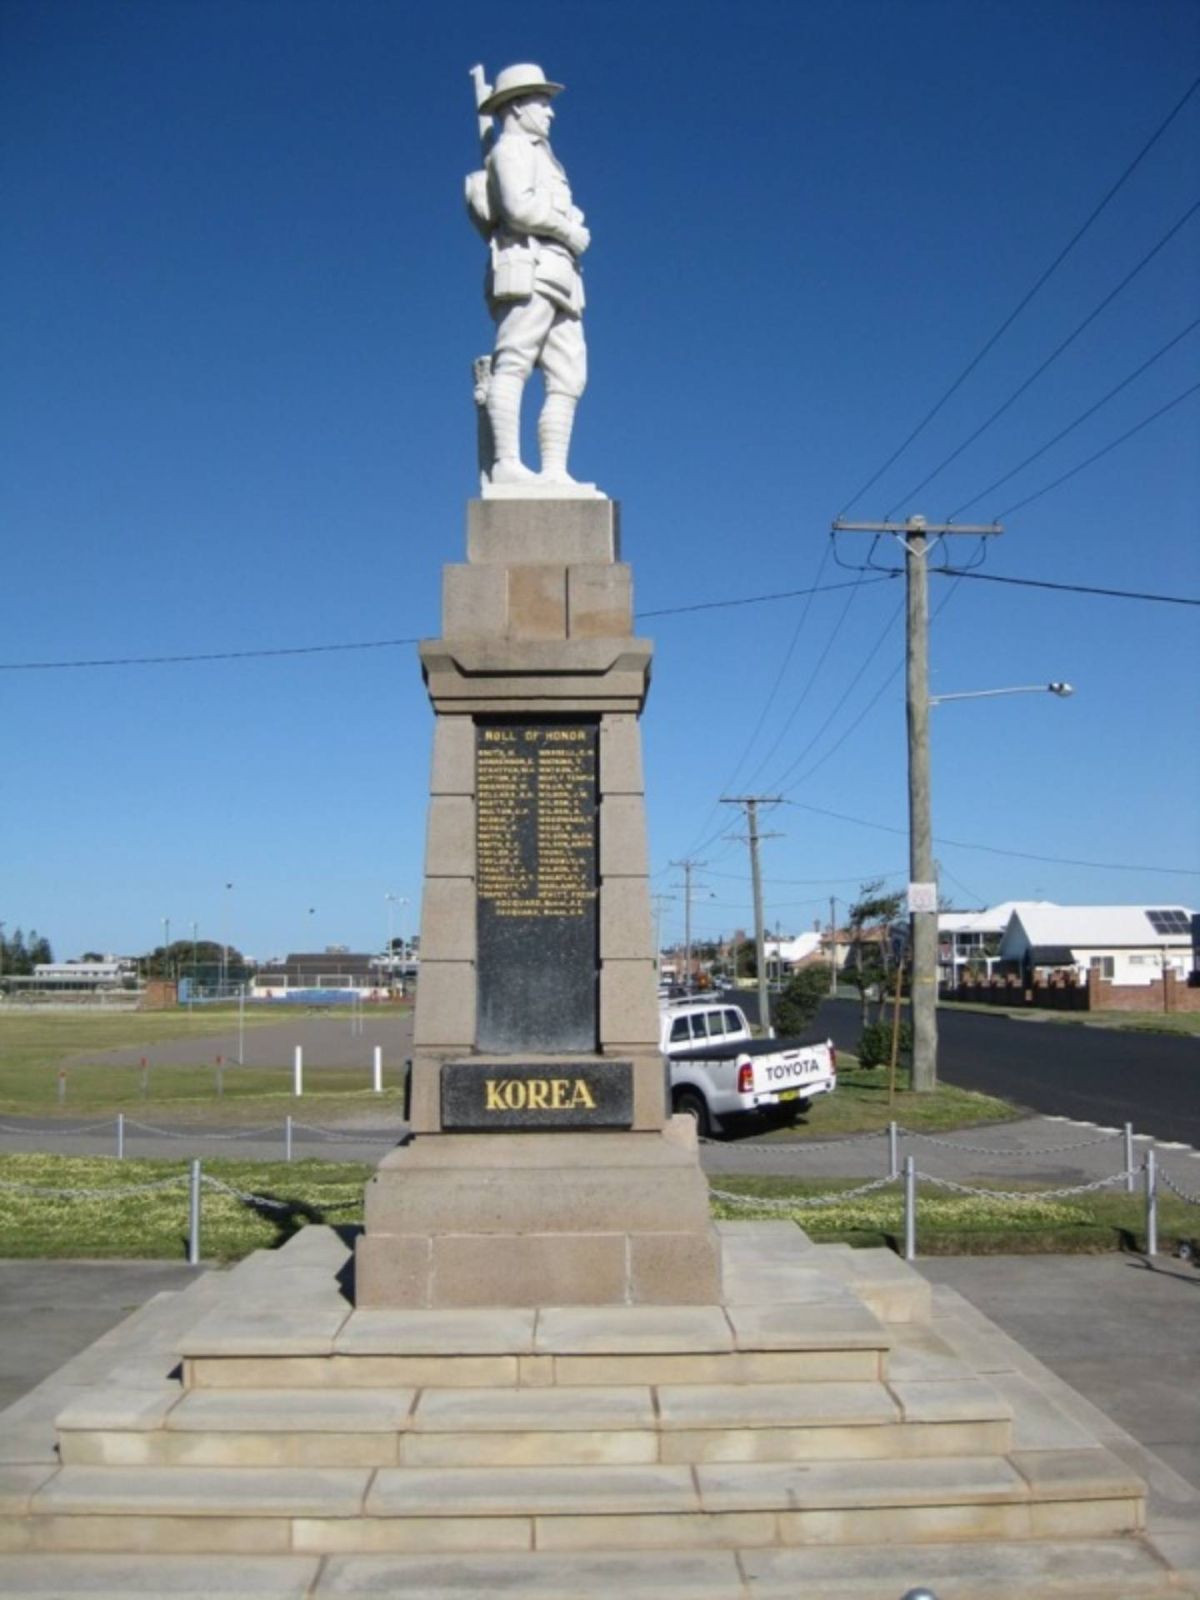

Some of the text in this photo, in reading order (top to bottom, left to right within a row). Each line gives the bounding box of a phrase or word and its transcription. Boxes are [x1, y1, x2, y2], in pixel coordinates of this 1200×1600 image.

[485, 731, 586, 741] ROLL OF HONOR
[766, 1059, 819, 1080] TOYOTA
[485, 1079, 597, 1110] KOREA
